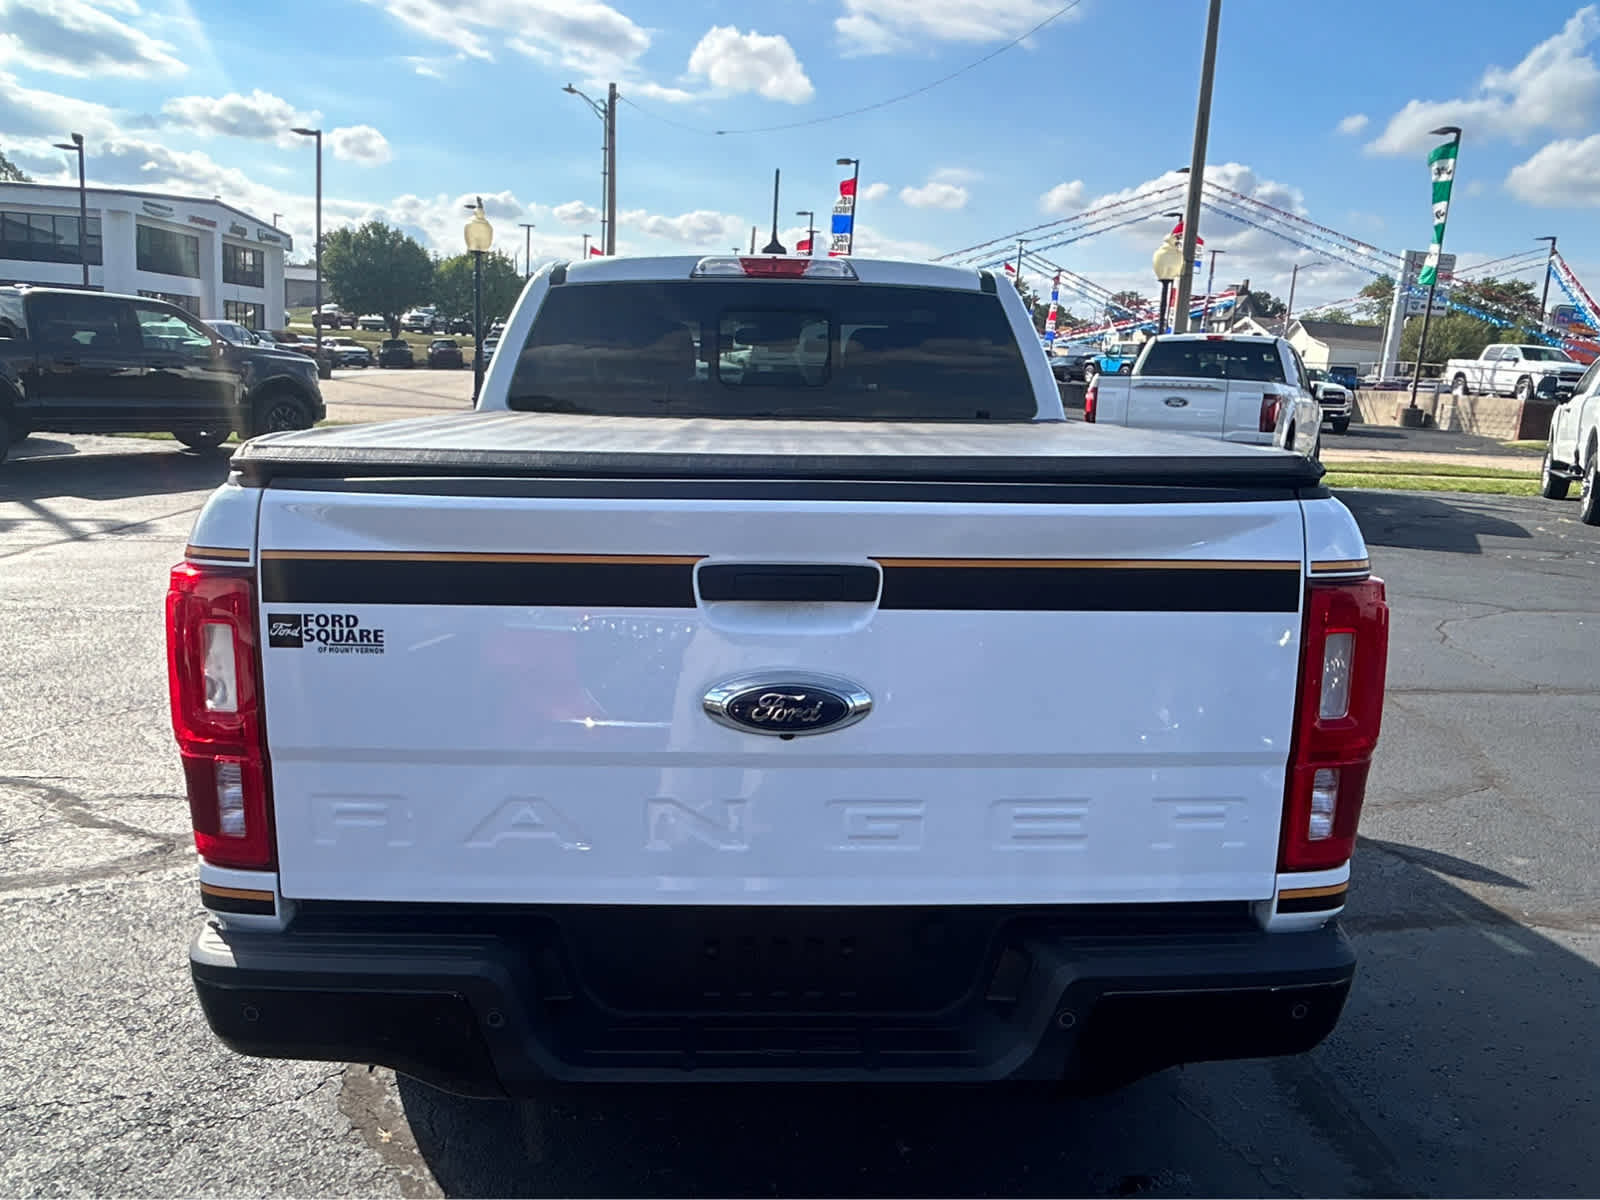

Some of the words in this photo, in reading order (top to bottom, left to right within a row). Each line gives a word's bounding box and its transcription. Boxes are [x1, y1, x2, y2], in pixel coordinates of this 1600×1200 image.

[303, 613, 359, 628] FORD
[269, 622, 301, 637] Ford
[303, 628, 385, 645] SQUARE
[317, 646, 328, 654] OF
[328, 646, 354, 654] MOUNT
[354, 646, 385, 654] VERNON
[751, 692, 823, 722] Ford
[310, 792, 1248, 852] RANGER
